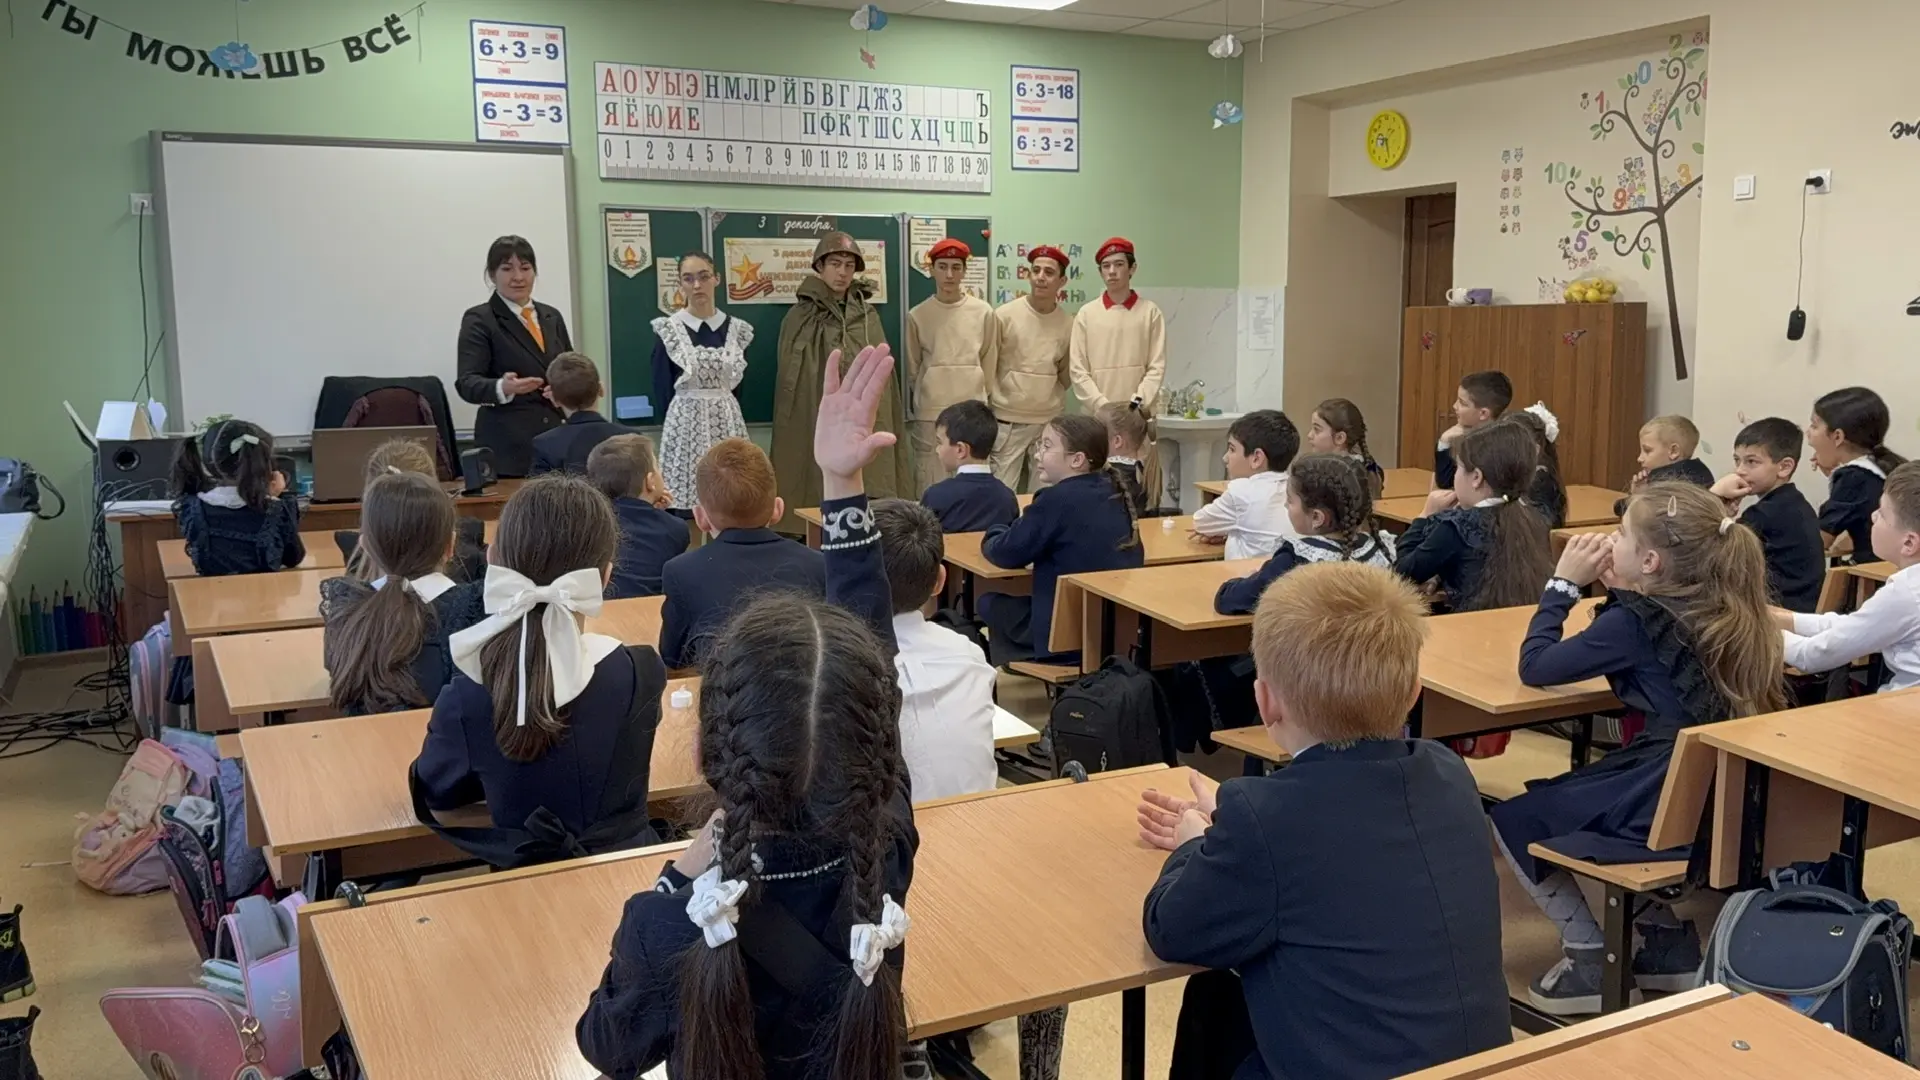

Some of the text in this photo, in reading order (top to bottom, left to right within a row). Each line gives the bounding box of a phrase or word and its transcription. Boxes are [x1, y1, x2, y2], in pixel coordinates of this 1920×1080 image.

[126, 31, 325, 78] МОЖШЬ
[342, 13, 412, 63] ВСЁ
[480, 39, 493, 56] 6
[513, 41, 526, 58] 3
[545, 43, 558, 60] 9
[1669, 34, 1682, 57] 2
[1638, 61, 1651, 84] 0
[602, 68, 989, 117] А О У Ы Э Н М Л Р Й Б В Г Д Ж З Ъ
[1017, 82, 1026, 96] 6
[1036, 83, 1045, 98] 3
[1057, 84, 1073, 99] 18
[483, 102, 497, 119] 6
[517, 104, 531, 121] 3
[549, 106, 562, 123] 3
[1594, 90, 1604, 114] 1
[605, 98, 988, 148] Я Ё Ю И Е П Ф К Т Ш С Х Ц Ч Щ Ь
[1017, 135, 1027, 150] 6
[1041, 136, 1050, 151] 3
[1064, 138, 1073, 152] 2
[605, 139, 988, 175] 0 1 2 3 4 5 6 7 8 9 10 11 12 13 14 15 16 17 18 19 20
[1544, 162, 1567, 184] 10
[1677, 164, 1692, 186] 3
[1613, 188, 1627, 210] 9
[758, 216, 766, 228] 3
[1574, 230, 1589, 252] 5
[1070, 265, 1079, 280] И
